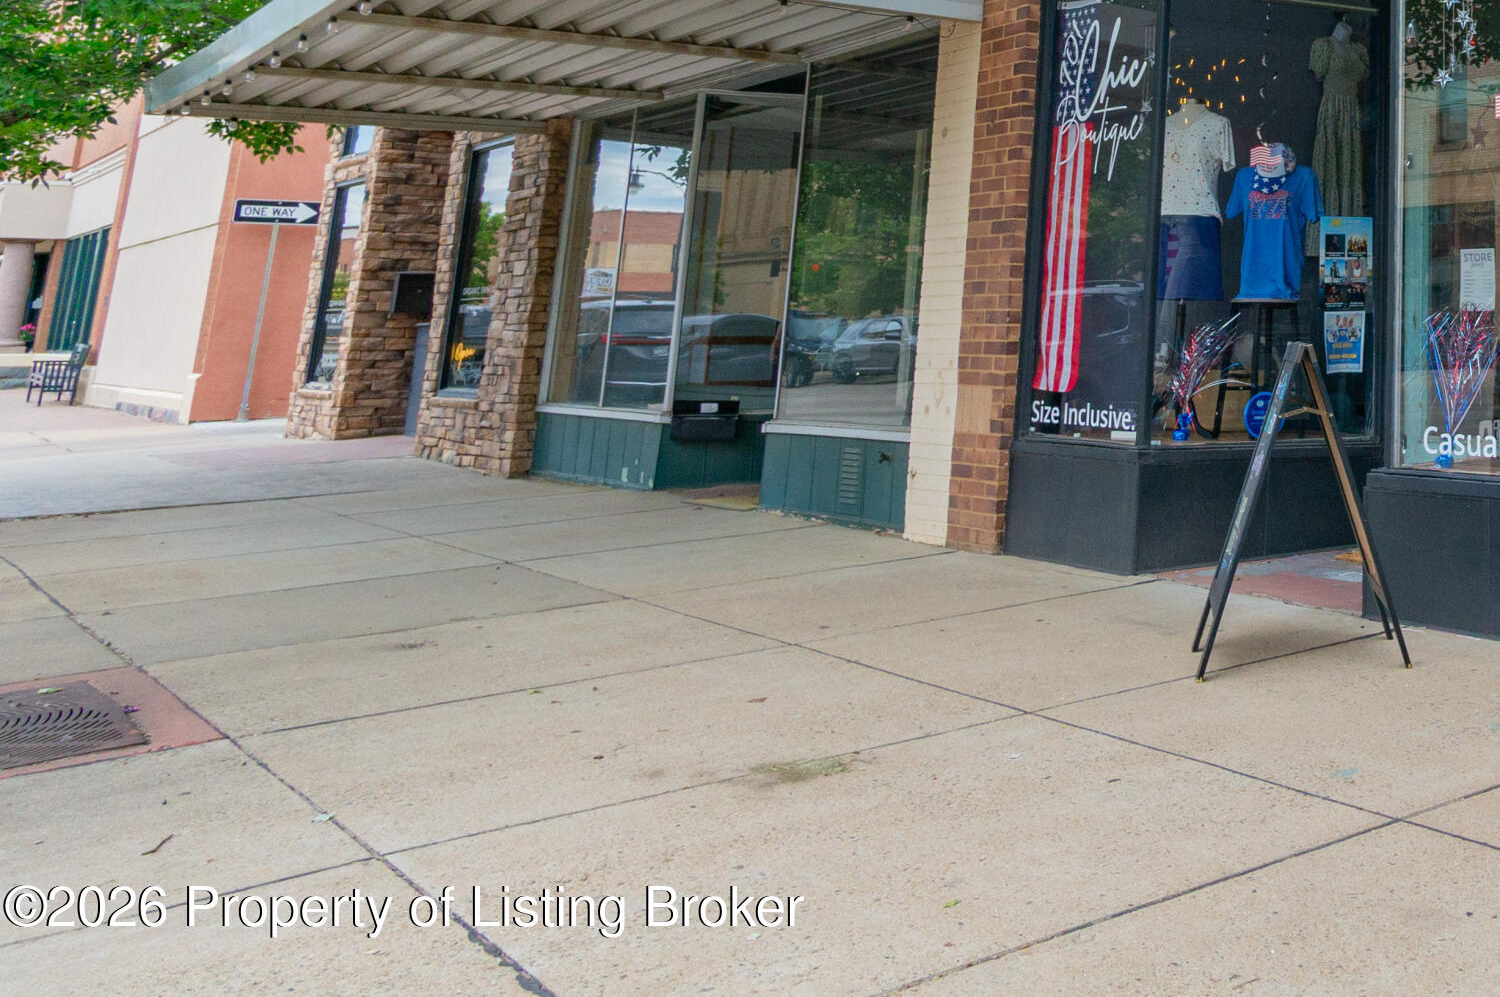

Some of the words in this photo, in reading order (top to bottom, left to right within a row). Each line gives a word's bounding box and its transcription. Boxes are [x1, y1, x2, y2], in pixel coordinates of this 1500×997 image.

[1075, 16, 1148, 122] Chic
[1053, 96, 1144, 182] Boutique
[244, 206, 268, 216] ONE
[272, 208, 297, 217] WAY
[1463, 252, 1493, 262] STORE
[1031, 400, 1060, 424] Size
[1063, 402, 1135, 431] Inclusive.
